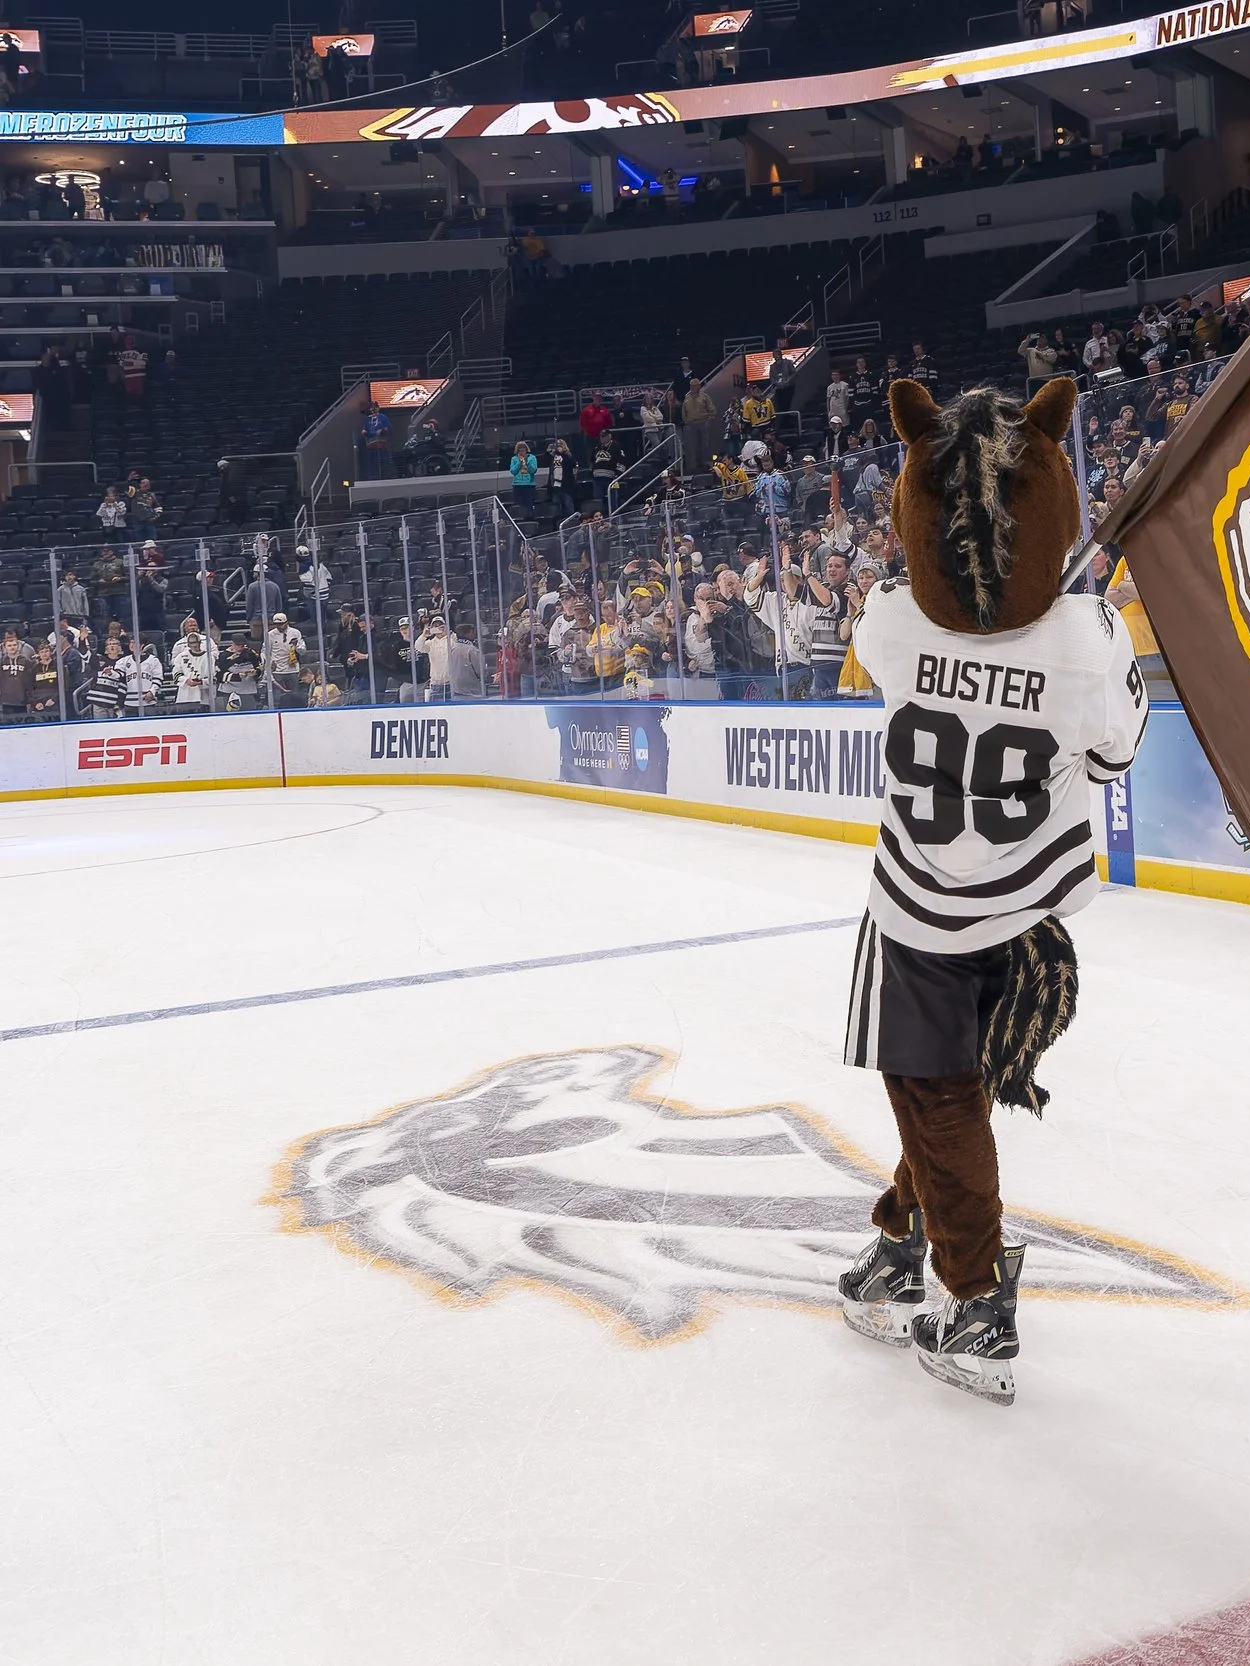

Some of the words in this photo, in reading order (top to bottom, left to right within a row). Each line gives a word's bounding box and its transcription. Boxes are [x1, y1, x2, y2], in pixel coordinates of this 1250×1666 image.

[915, 653, 1046, 712] BUSTER
[77, 734, 187, 770] ESPN
[369, 718, 449, 759] DENVER
[568, 721, 616, 757] Olympians
[574, 757, 590, 768] MADE
[590, 759, 606, 769] HERE
[725, 727, 831, 795] WESTERN
[964, 1326, 998, 1355] CCM
